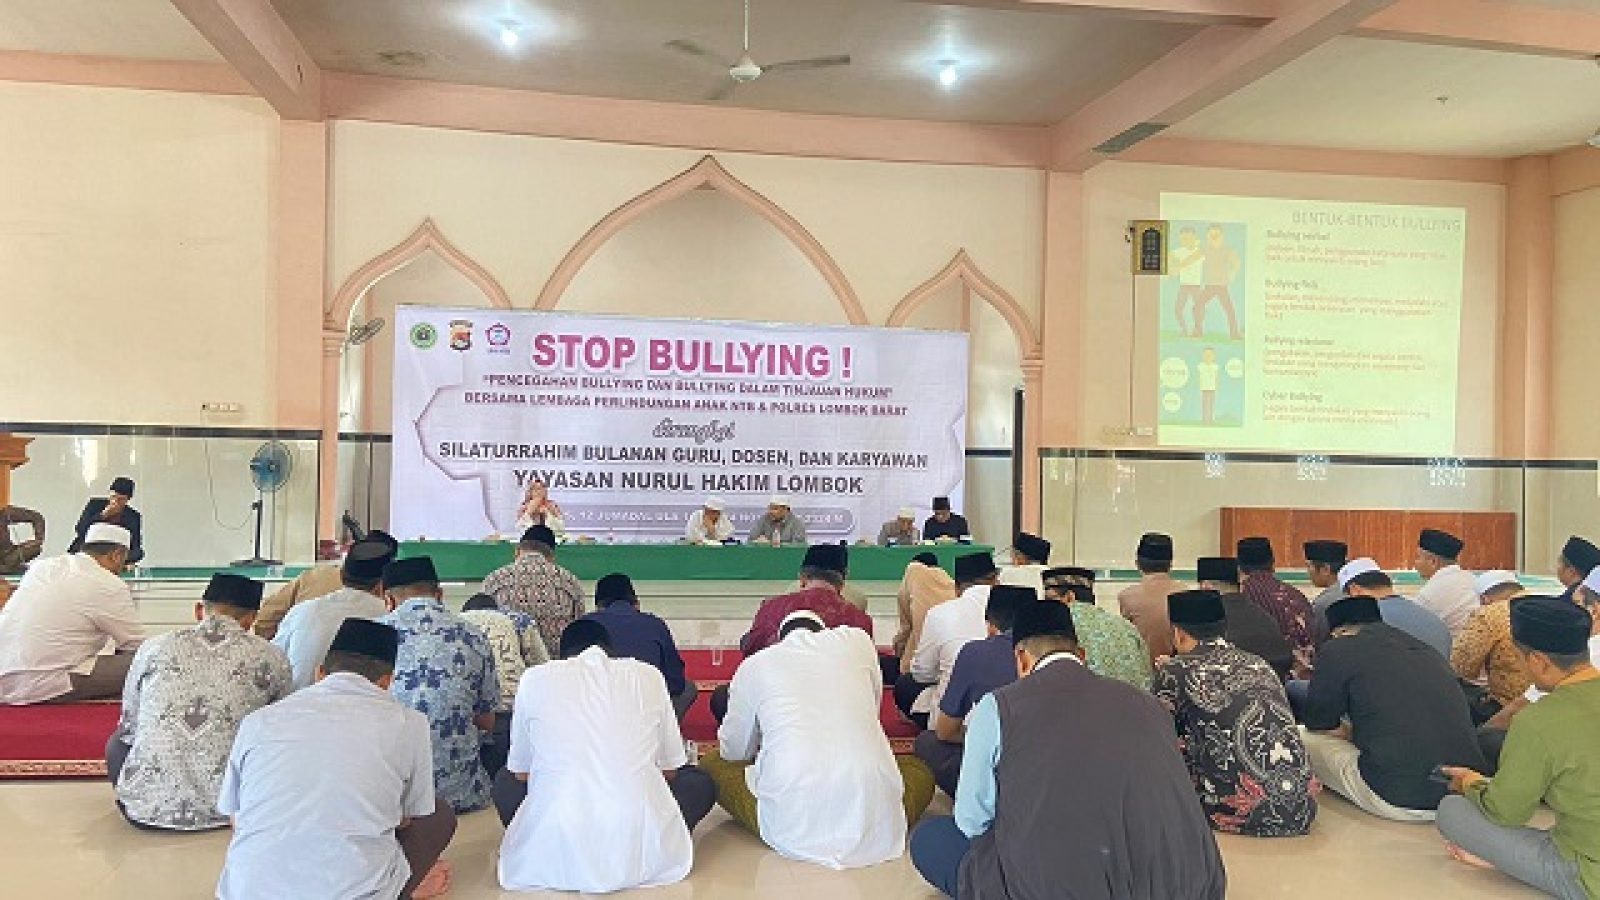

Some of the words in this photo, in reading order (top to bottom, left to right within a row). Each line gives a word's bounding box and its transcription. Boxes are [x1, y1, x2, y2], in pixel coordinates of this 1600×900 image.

[1291, 211, 1398, 229] BENTUK-BENTUK
[1402, 217, 1461, 233] BULLYING
[1266, 230, 1300, 241] Bullying
[532, 334, 636, 369] STOP
[649, 338, 831, 378] BULLYING
[841, 346, 852, 379] !
[581, 377, 643, 390] BULLYING
[646, 379, 672, 392] DAN
[674, 380, 736, 394] BULLYING
[738, 383, 780, 395] DALAM
[782, 384, 841, 397] TINJAUAN
[464, 391, 527, 404] BERSAMA
[529, 393, 591, 406] LEMBAGA
[594, 396, 691, 410] PERLINDUNGAN
[694, 399, 728, 412] ANAK
[730, 400, 756, 412] NTB
[770, 402, 816, 414] POLRES
[819, 403, 869, 415] LOMBOK
[871, 404, 908, 416] BARAT
[438, 442, 577, 459] SILATURRAHIM
[583, 445, 667, 462] BULANAN
[672, 447, 726, 466] GURU,
[731, 449, 794, 468] DOSEN,
[799, 450, 832, 467] DAN
[836, 452, 929, 469] KARYAWAN
[513, 469, 614, 490] YAYASAN
[620, 471, 695, 491] NURUL
[701, 473, 770, 492] HAKIM
[776, 475, 864, 494] LOMBOK
